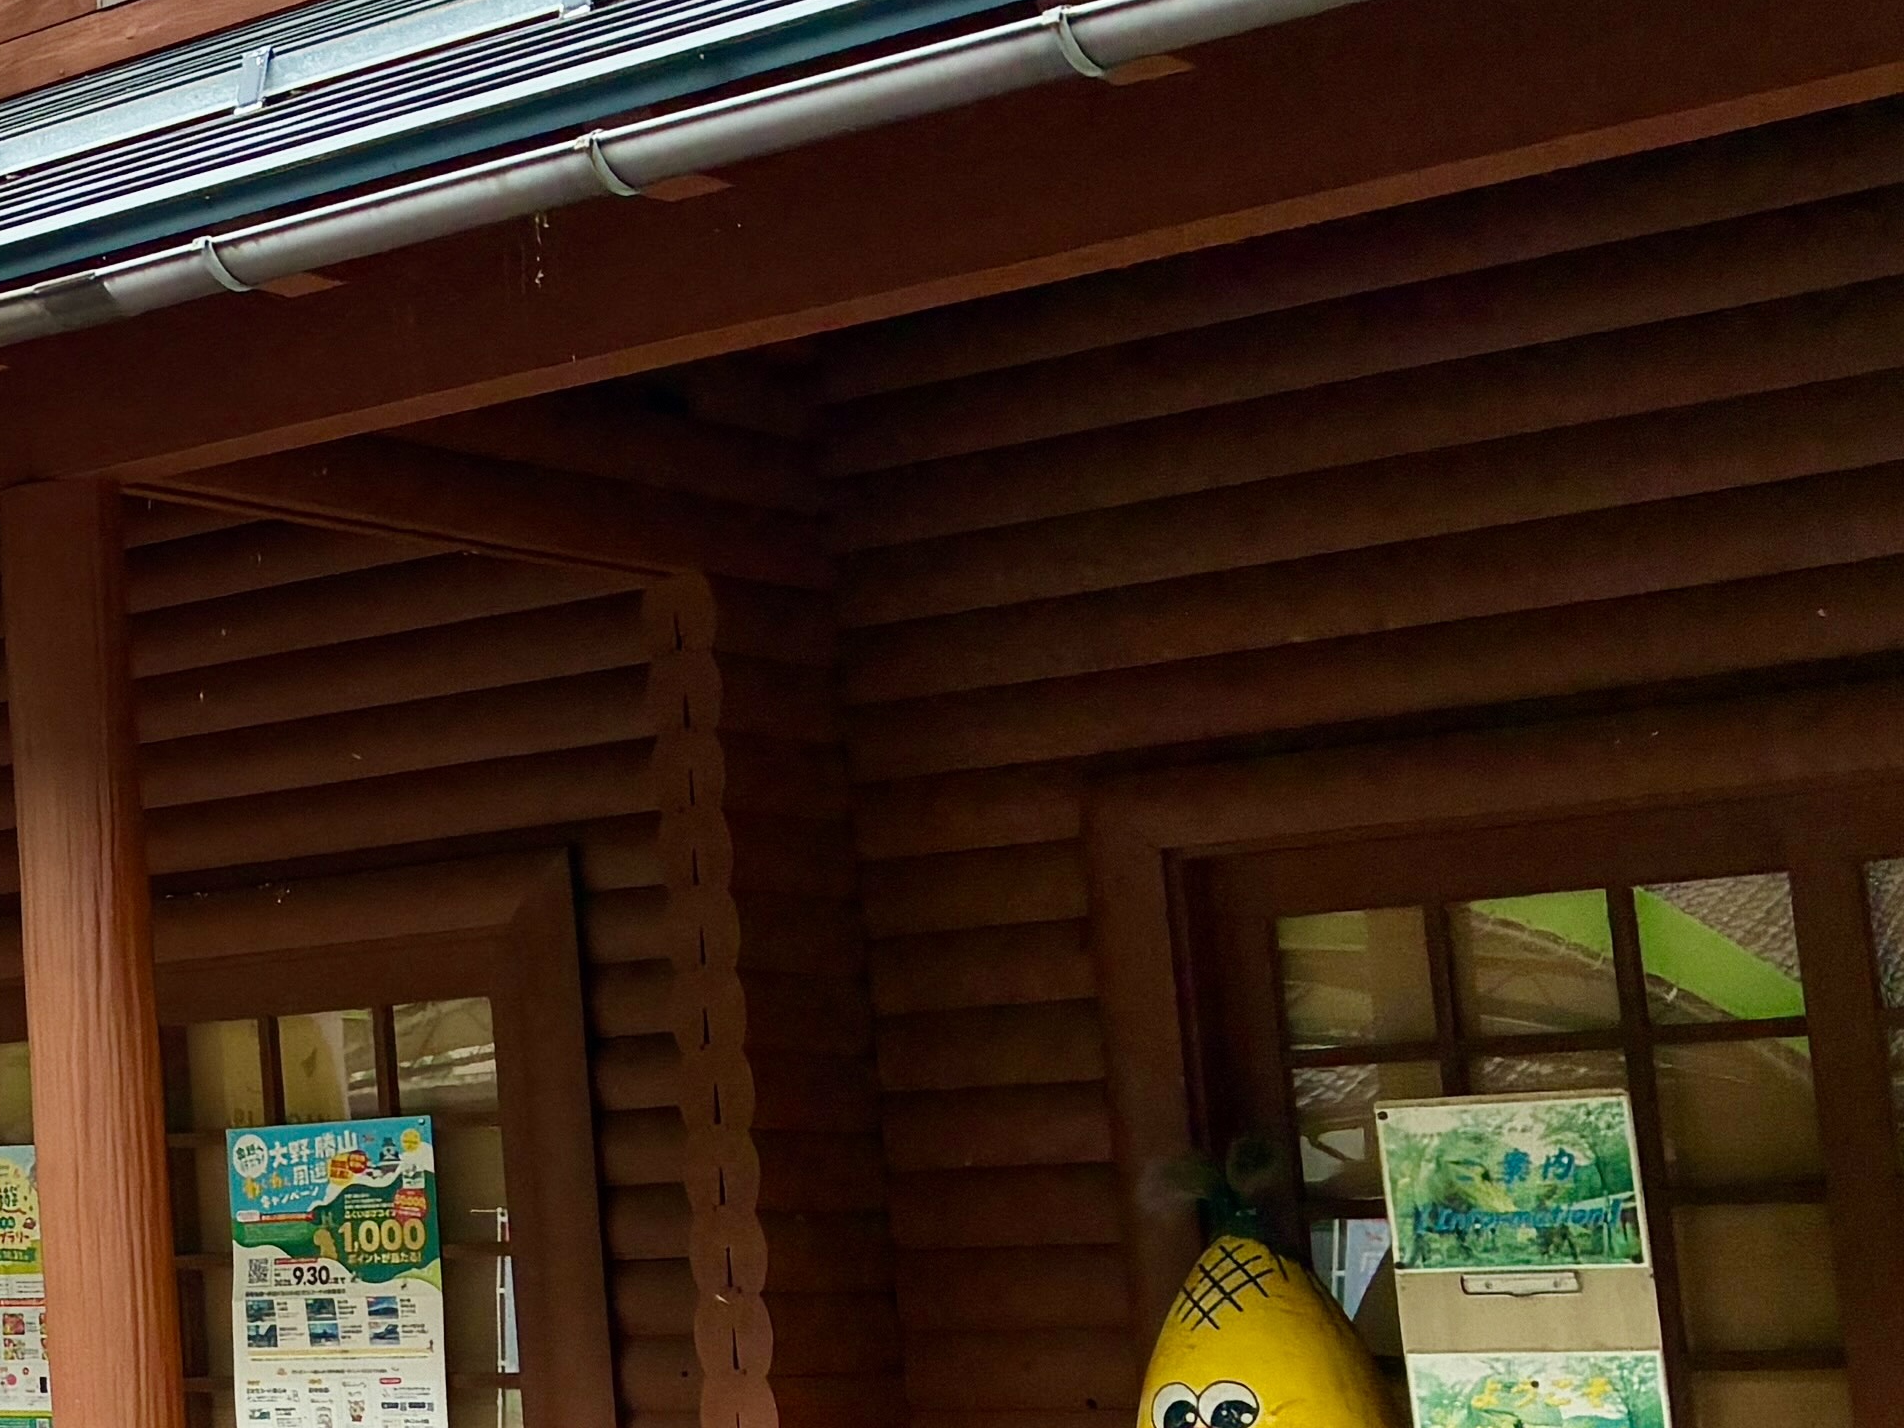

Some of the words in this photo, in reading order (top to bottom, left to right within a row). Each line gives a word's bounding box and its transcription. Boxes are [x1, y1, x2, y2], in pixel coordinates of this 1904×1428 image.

[338, 1219, 426, 1253] 1,000
[292, 1265, 330, 1286] 9.30
[1471, 1377, 1613, 1410] ようこそ
